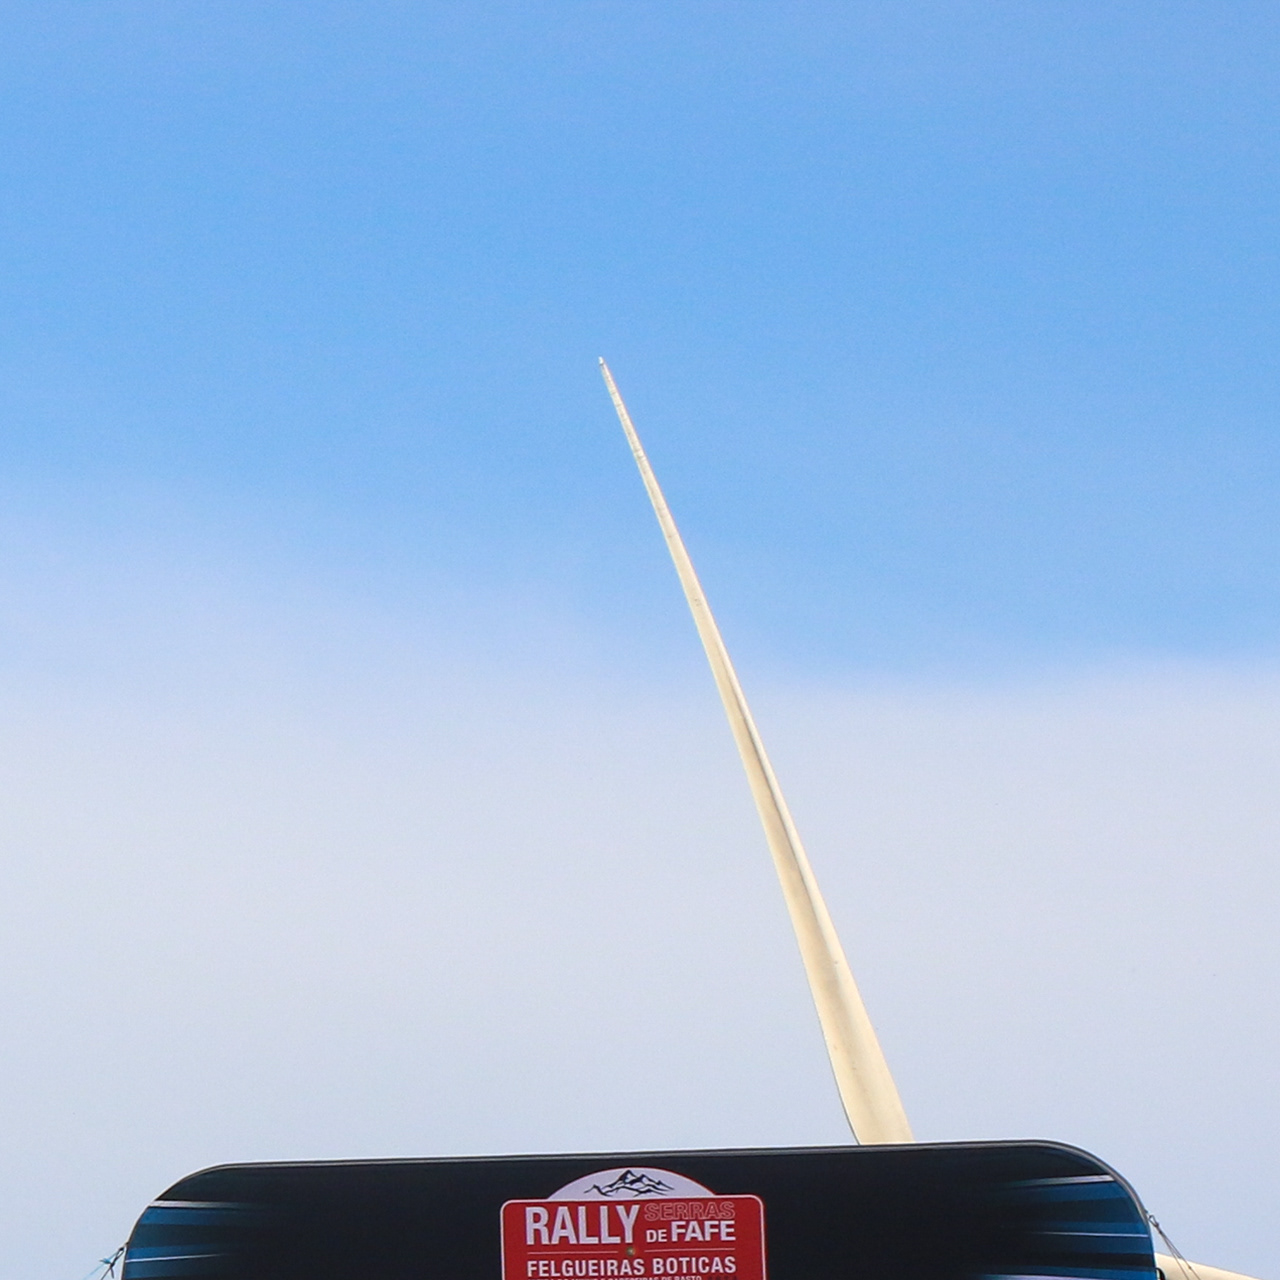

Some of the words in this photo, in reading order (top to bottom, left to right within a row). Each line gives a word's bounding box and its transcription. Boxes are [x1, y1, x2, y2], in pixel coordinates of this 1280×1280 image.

[644, 1201, 736, 1221] SERRAS
[525, 1204, 640, 1246] RALLY
[646, 1229, 667, 1243] DE
[671, 1220, 736, 1242] FAFE
[527, 1258, 645, 1277] FELGUEIRAS
[653, 1256, 736, 1274] BOTICAS
